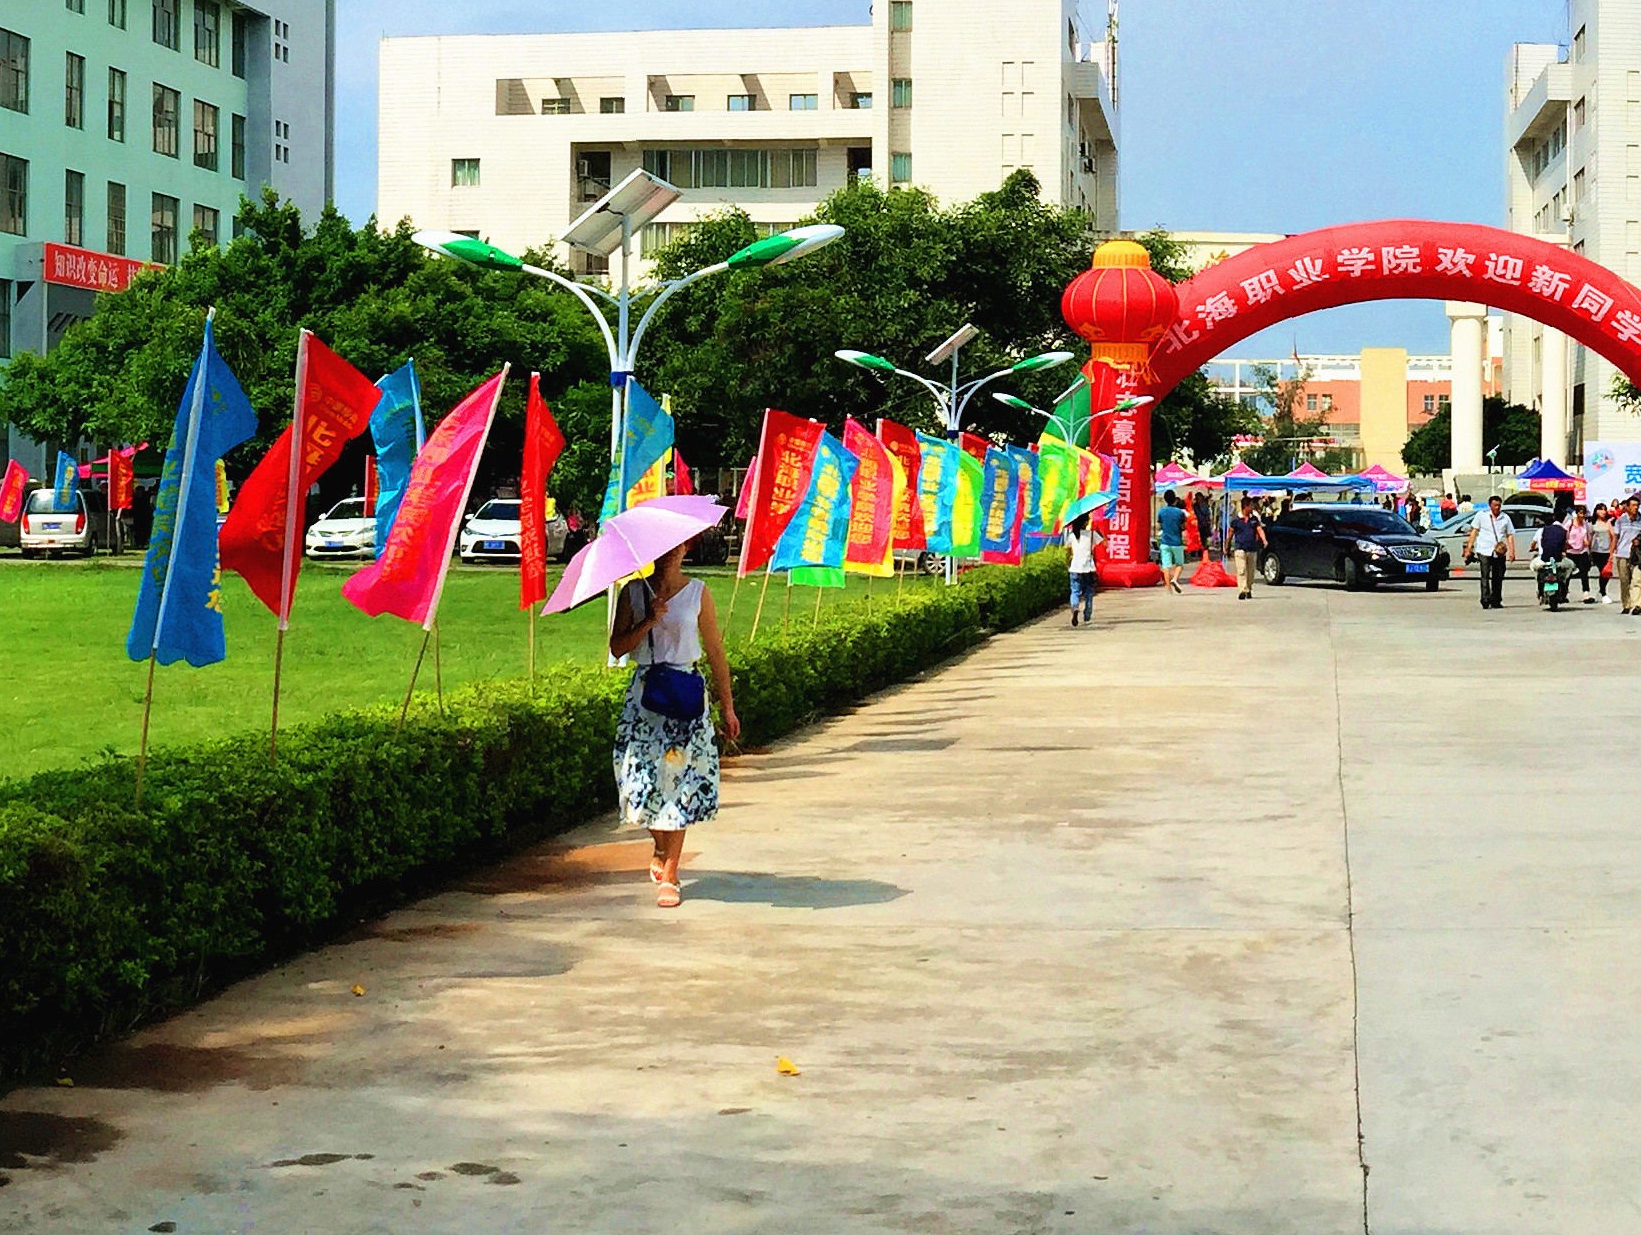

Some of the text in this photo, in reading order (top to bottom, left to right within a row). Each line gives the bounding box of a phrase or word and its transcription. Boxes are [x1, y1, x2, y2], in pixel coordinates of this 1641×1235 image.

[53, 249, 120, 289] 知识改变命运
